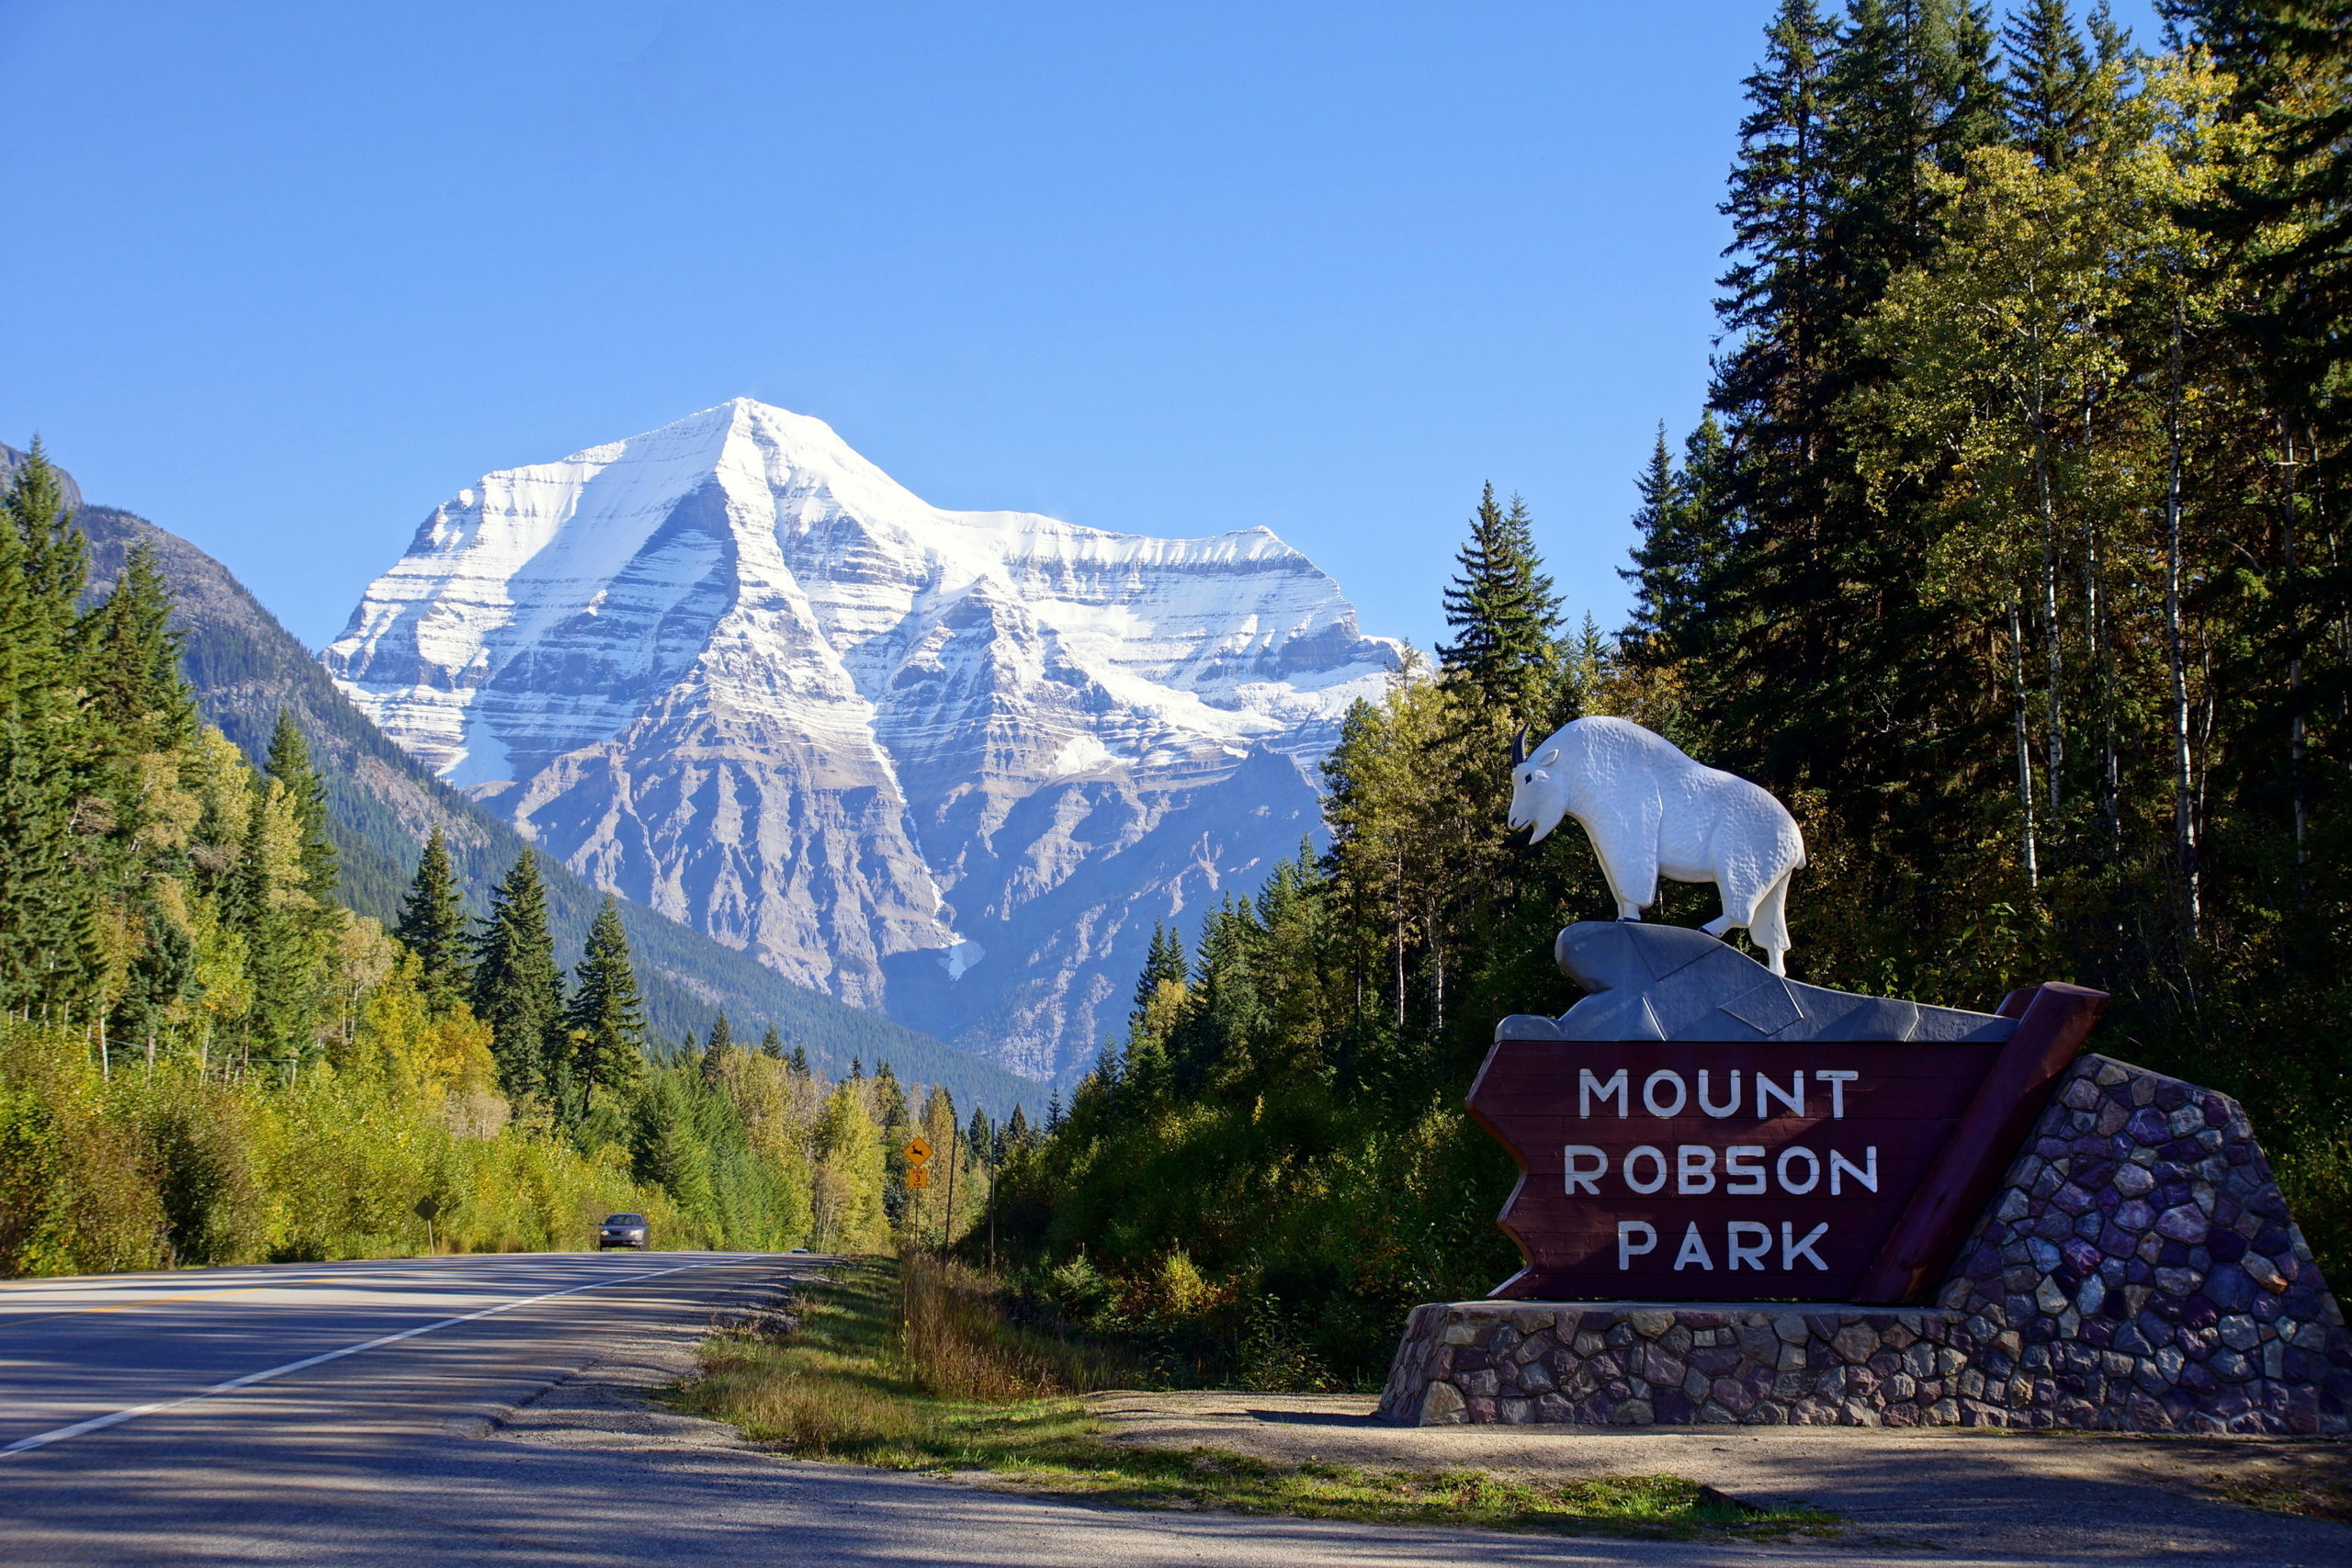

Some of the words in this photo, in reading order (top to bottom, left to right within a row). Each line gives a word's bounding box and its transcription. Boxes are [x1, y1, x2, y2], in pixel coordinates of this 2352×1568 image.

[1579, 1068, 1859, 1119] MOUNT
[1564, 1145, 1878, 1196] ROBSON
[1617, 1220, 1829, 1270] PARK
